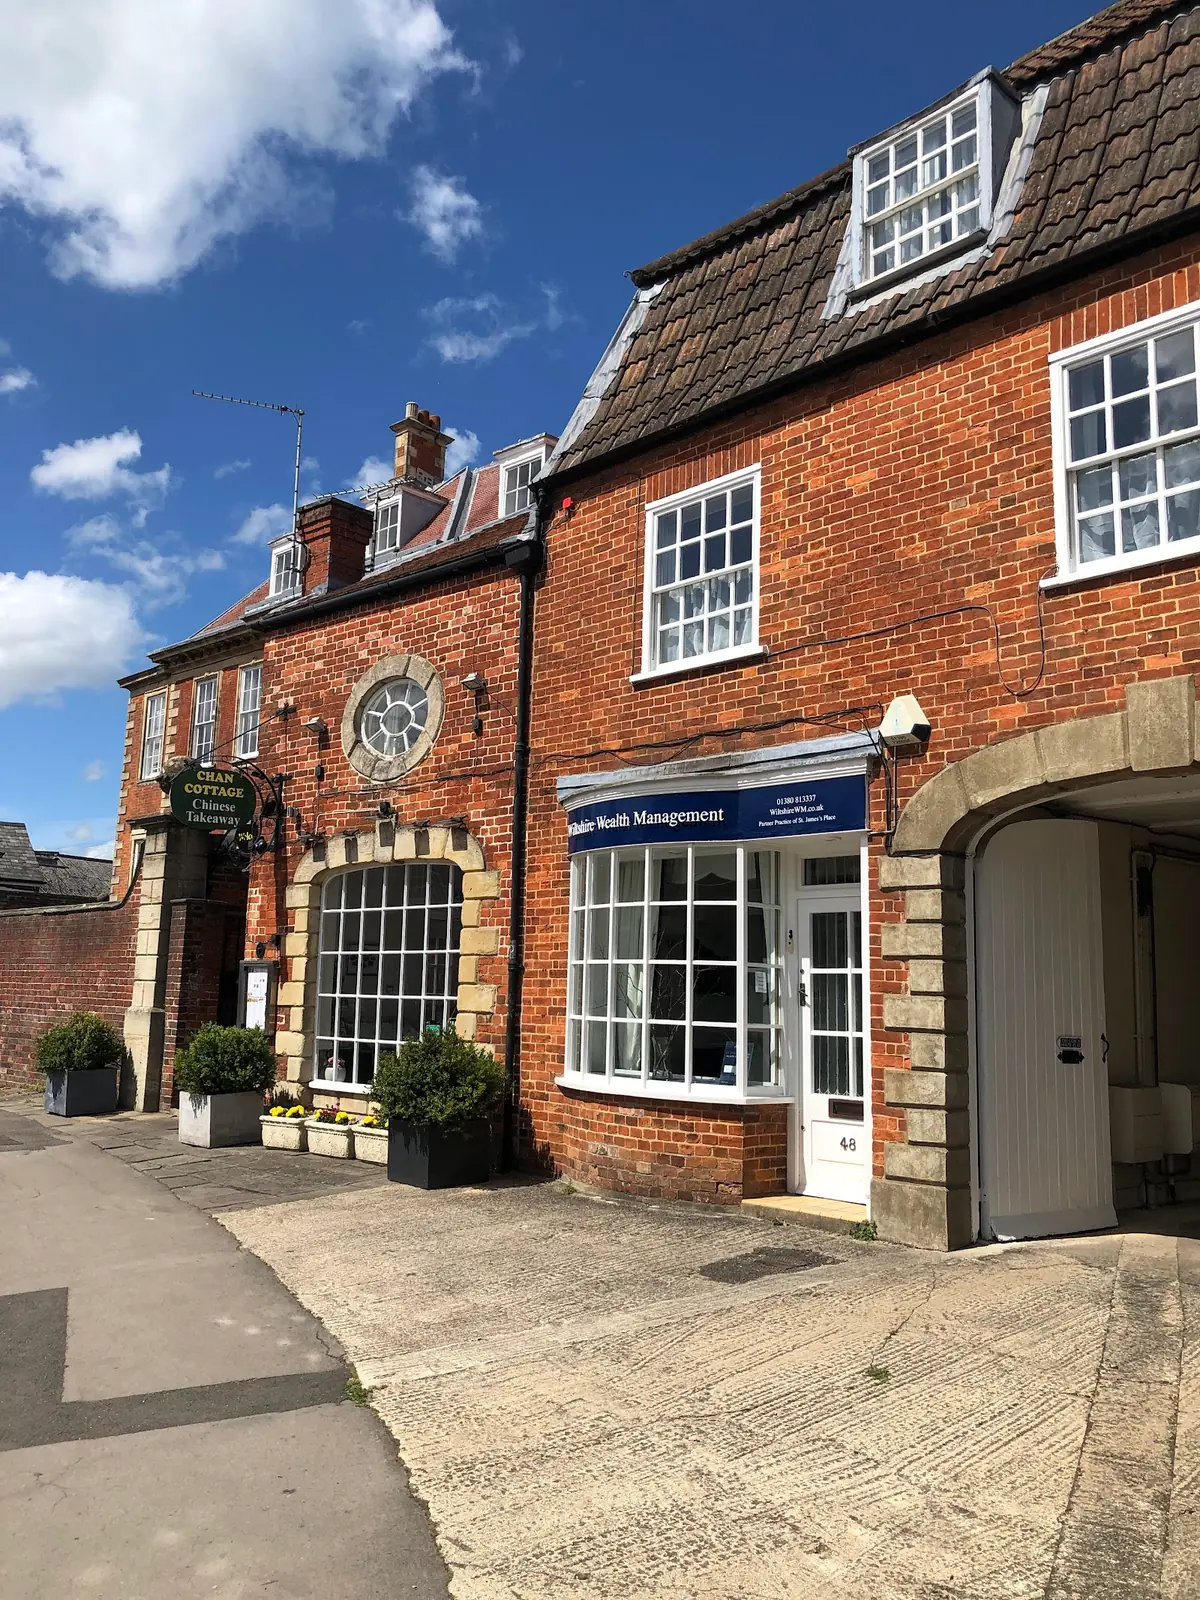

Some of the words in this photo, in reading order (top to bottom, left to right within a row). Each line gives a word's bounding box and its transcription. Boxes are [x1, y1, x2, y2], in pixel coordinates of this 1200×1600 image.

[197, 770, 234, 783] CHAN
[184, 783, 244, 798] COTTAGE
[192, 798, 236, 812] Chinese
[776, 797, 794, 805] 01380
[795, 794, 816, 803] 813337
[769, 804, 824, 815] WiltshireWM.co.uk
[186, 810, 240, 828] Takeaway
[568, 819, 595, 837] Wiltshire
[596, 813, 630, 830] Wealth
[633, 808, 724, 827] Management
[840, 1136, 856, 1152] 48
